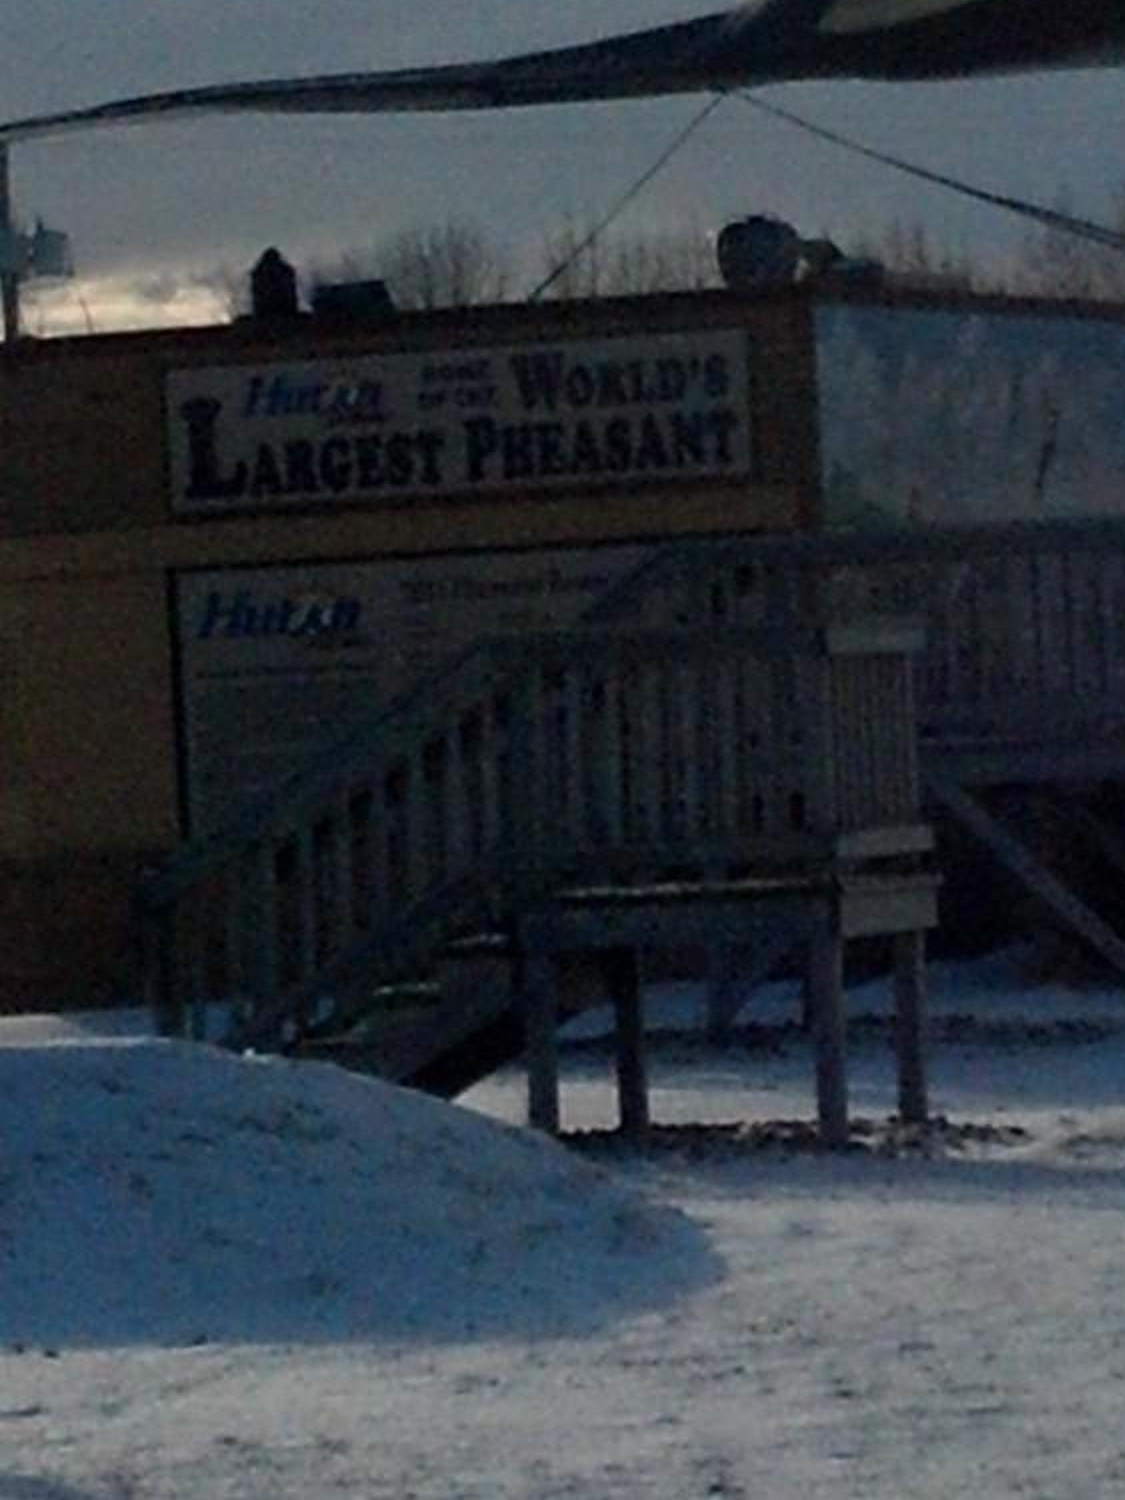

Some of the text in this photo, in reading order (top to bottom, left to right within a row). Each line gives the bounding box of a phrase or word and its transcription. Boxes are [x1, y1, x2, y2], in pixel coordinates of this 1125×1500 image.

[510, 352, 731, 411] WORLD'S
[180, 397, 738, 497] LARGEST PHEASANT
